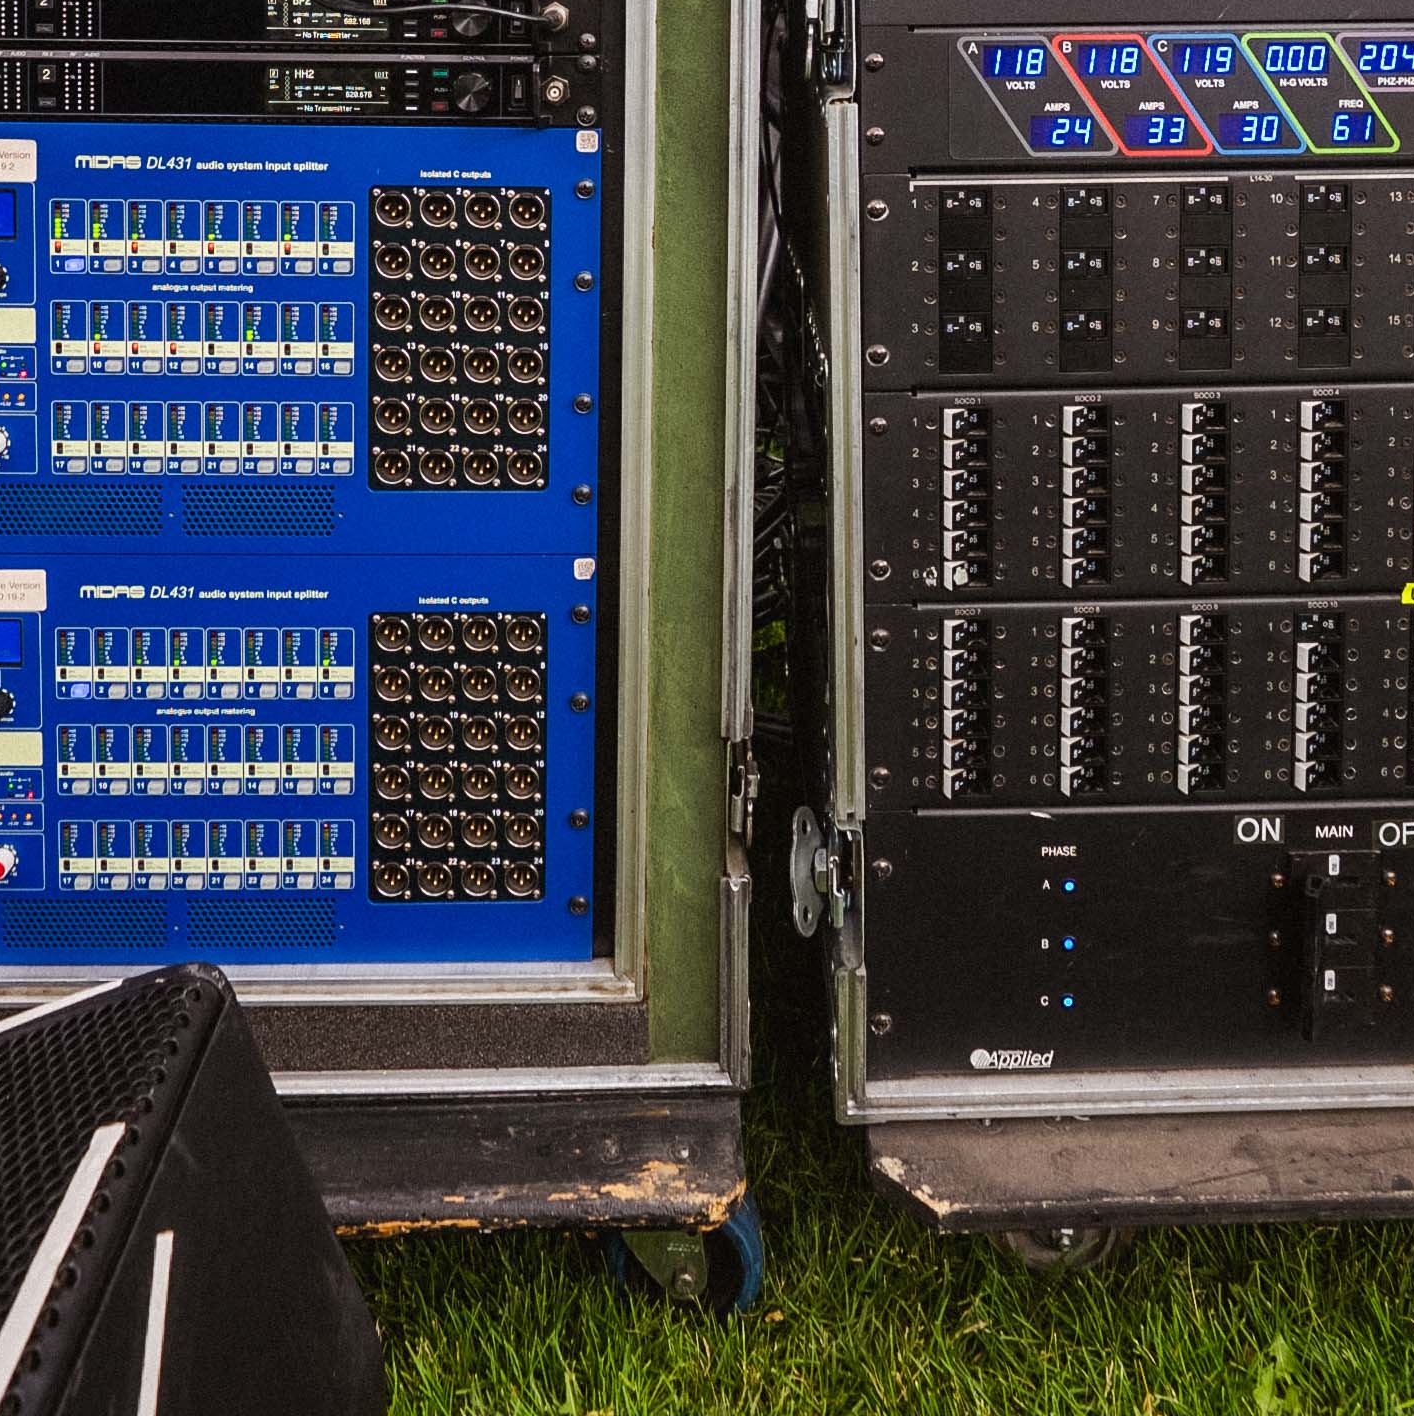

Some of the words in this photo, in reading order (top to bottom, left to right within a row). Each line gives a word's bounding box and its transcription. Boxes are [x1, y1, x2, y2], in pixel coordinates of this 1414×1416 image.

[968, 42, 978, 54] A
[1063, 41, 1072, 53] B
[1158, 40, 1167, 52] C
[995, 49, 1043, 74] 118
[1089, 48, 1138, 73] 118
[1184, 47, 1232, 72] 119
[1266, 46, 1325, 71] 0.00
[43, 69, 50, 79] 2
[295, 69, 314, 78] HH2
[1006, 81, 1035, 90] VOLTS
[1101, 80, 1130, 88] VOLTS
[1195, 79, 1225, 88] VOLTS
[1280, 78, 1297, 86] N-G
[1300, 78, 1328, 86] VOLTS
[1044, 103, 1070, 111] AMPS
[1139, 102, 1165, 110] AMPS
[1233, 101, 1259, 109] AMPS
[1339, 100, 1363, 108] FREQ
[1052, 119, 1091, 144] 24
[1149, 118, 1185, 143] 33
[1243, 116, 1278, 141] 30
[1334, 115, 1371, 140] 61
[75, 155, 141, 169] MIDAS
[147, 156, 191, 169] DL431
[196, 161, 224, 169] audio
[227, 162, 262, 172] system
[265, 161, 291, 172] input
[293, 162, 328, 172] splitter
[453, 170, 460, 178] C
[461, 171, 491, 179] outputs
[1271, 193, 1283, 203] 10
[1390, 192, 1402, 201] 13
[1389, 254, 1401, 263] 14
[152, 284, 188, 292] analogue
[190, 284, 216, 292] output
[218, 284, 253, 293] metering
[1270, 317, 1281, 327] 12
[9, 582, 41, 590] Version
[80, 586, 145, 598] MIDAS
[150, 586, 194, 598] DL431
[199, 590, 226, 598] audio
[229, 591, 264, 600] system
[267, 590, 292, 600] input
[294, 590, 328, 600] splitter
[459, 597, 489, 605] outputs
[156, 708, 192, 716] analogue
[194, 708, 219, 716] output
[221, 708, 255, 716] metering
[1237, 818, 1280, 842] ON
[1316, 825, 1353, 838] MAIN
[1042, 846, 1076, 856] PHASE
[1043, 880, 1050, 889] A
[1042, 939, 1049, 949] B
[1041, 996, 1048, 1006] C
[988, 1050, 1054, 1069] Applied
